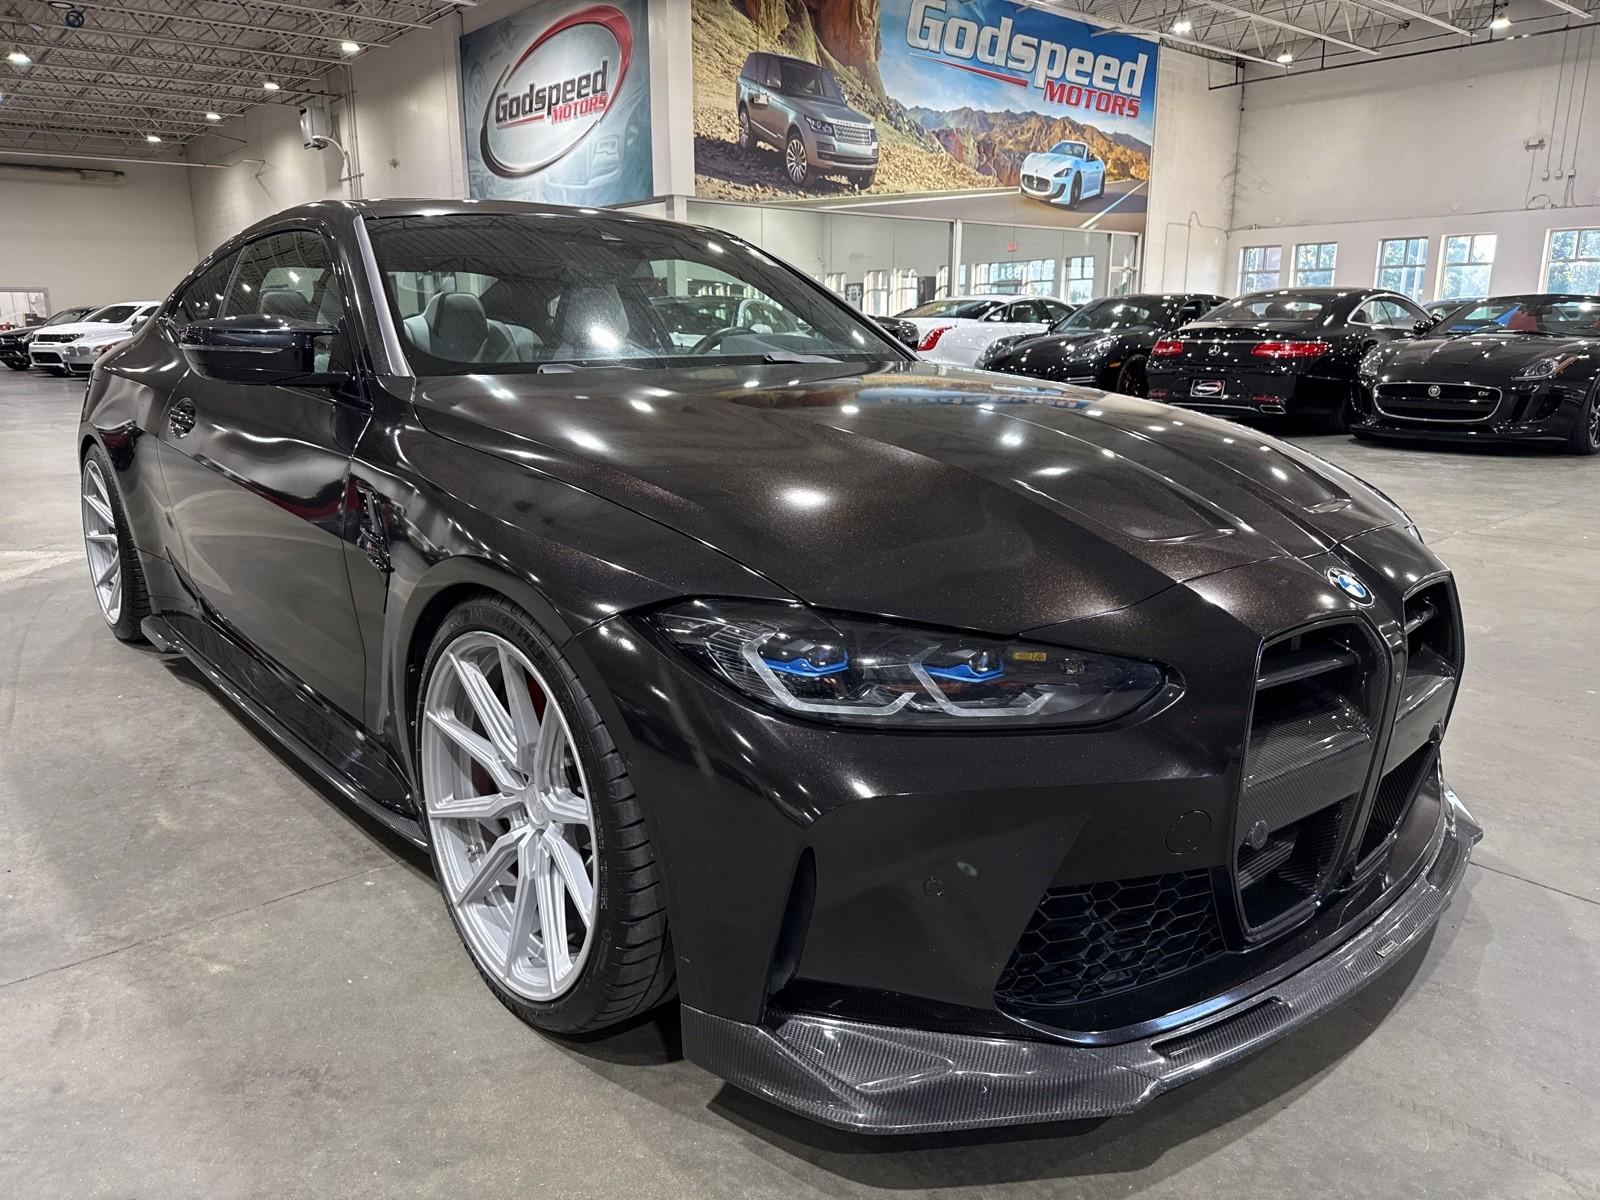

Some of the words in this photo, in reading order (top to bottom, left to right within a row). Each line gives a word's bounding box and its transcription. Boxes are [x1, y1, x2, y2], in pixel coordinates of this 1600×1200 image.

[906, 0, 1149, 97] Godspeed
[495, 60, 608, 123] Godspeed
[551, 92, 607, 124] MOTORS
[1043, 79, 1140, 118] MOTORS
